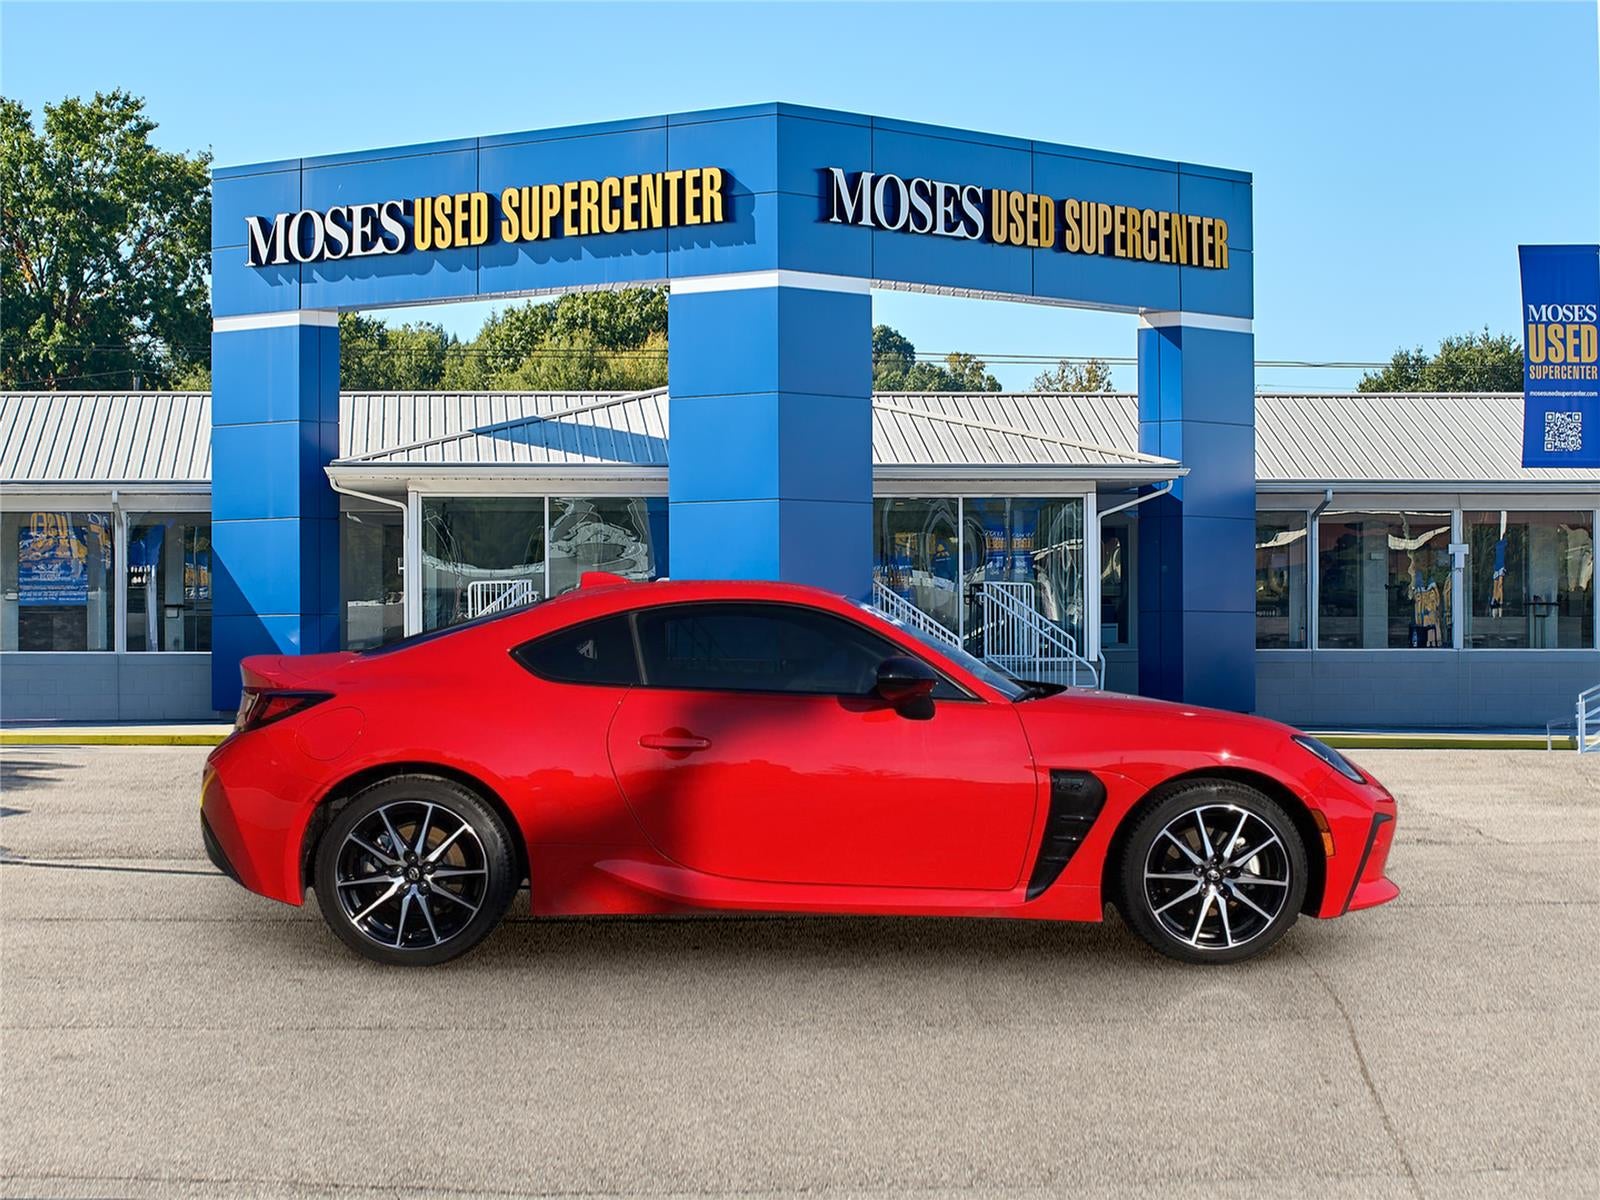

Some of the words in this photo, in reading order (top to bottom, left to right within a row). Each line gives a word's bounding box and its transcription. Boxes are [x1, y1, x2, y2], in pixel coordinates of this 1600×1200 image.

[244, 200, 406, 268] MOSES
[413, 191, 489, 252] USED
[500, 166, 724, 244] SUPERCENTER
[829, 167, 985, 241] MOSES
[991, 188, 1055, 249] USED
[1065, 198, 1230, 270] SUPERCENTER
[1528, 304, 1598, 322] MOSES
[1528, 324, 1598, 363] USED
[1529, 365, 1598, 380] SUPERCENTER
